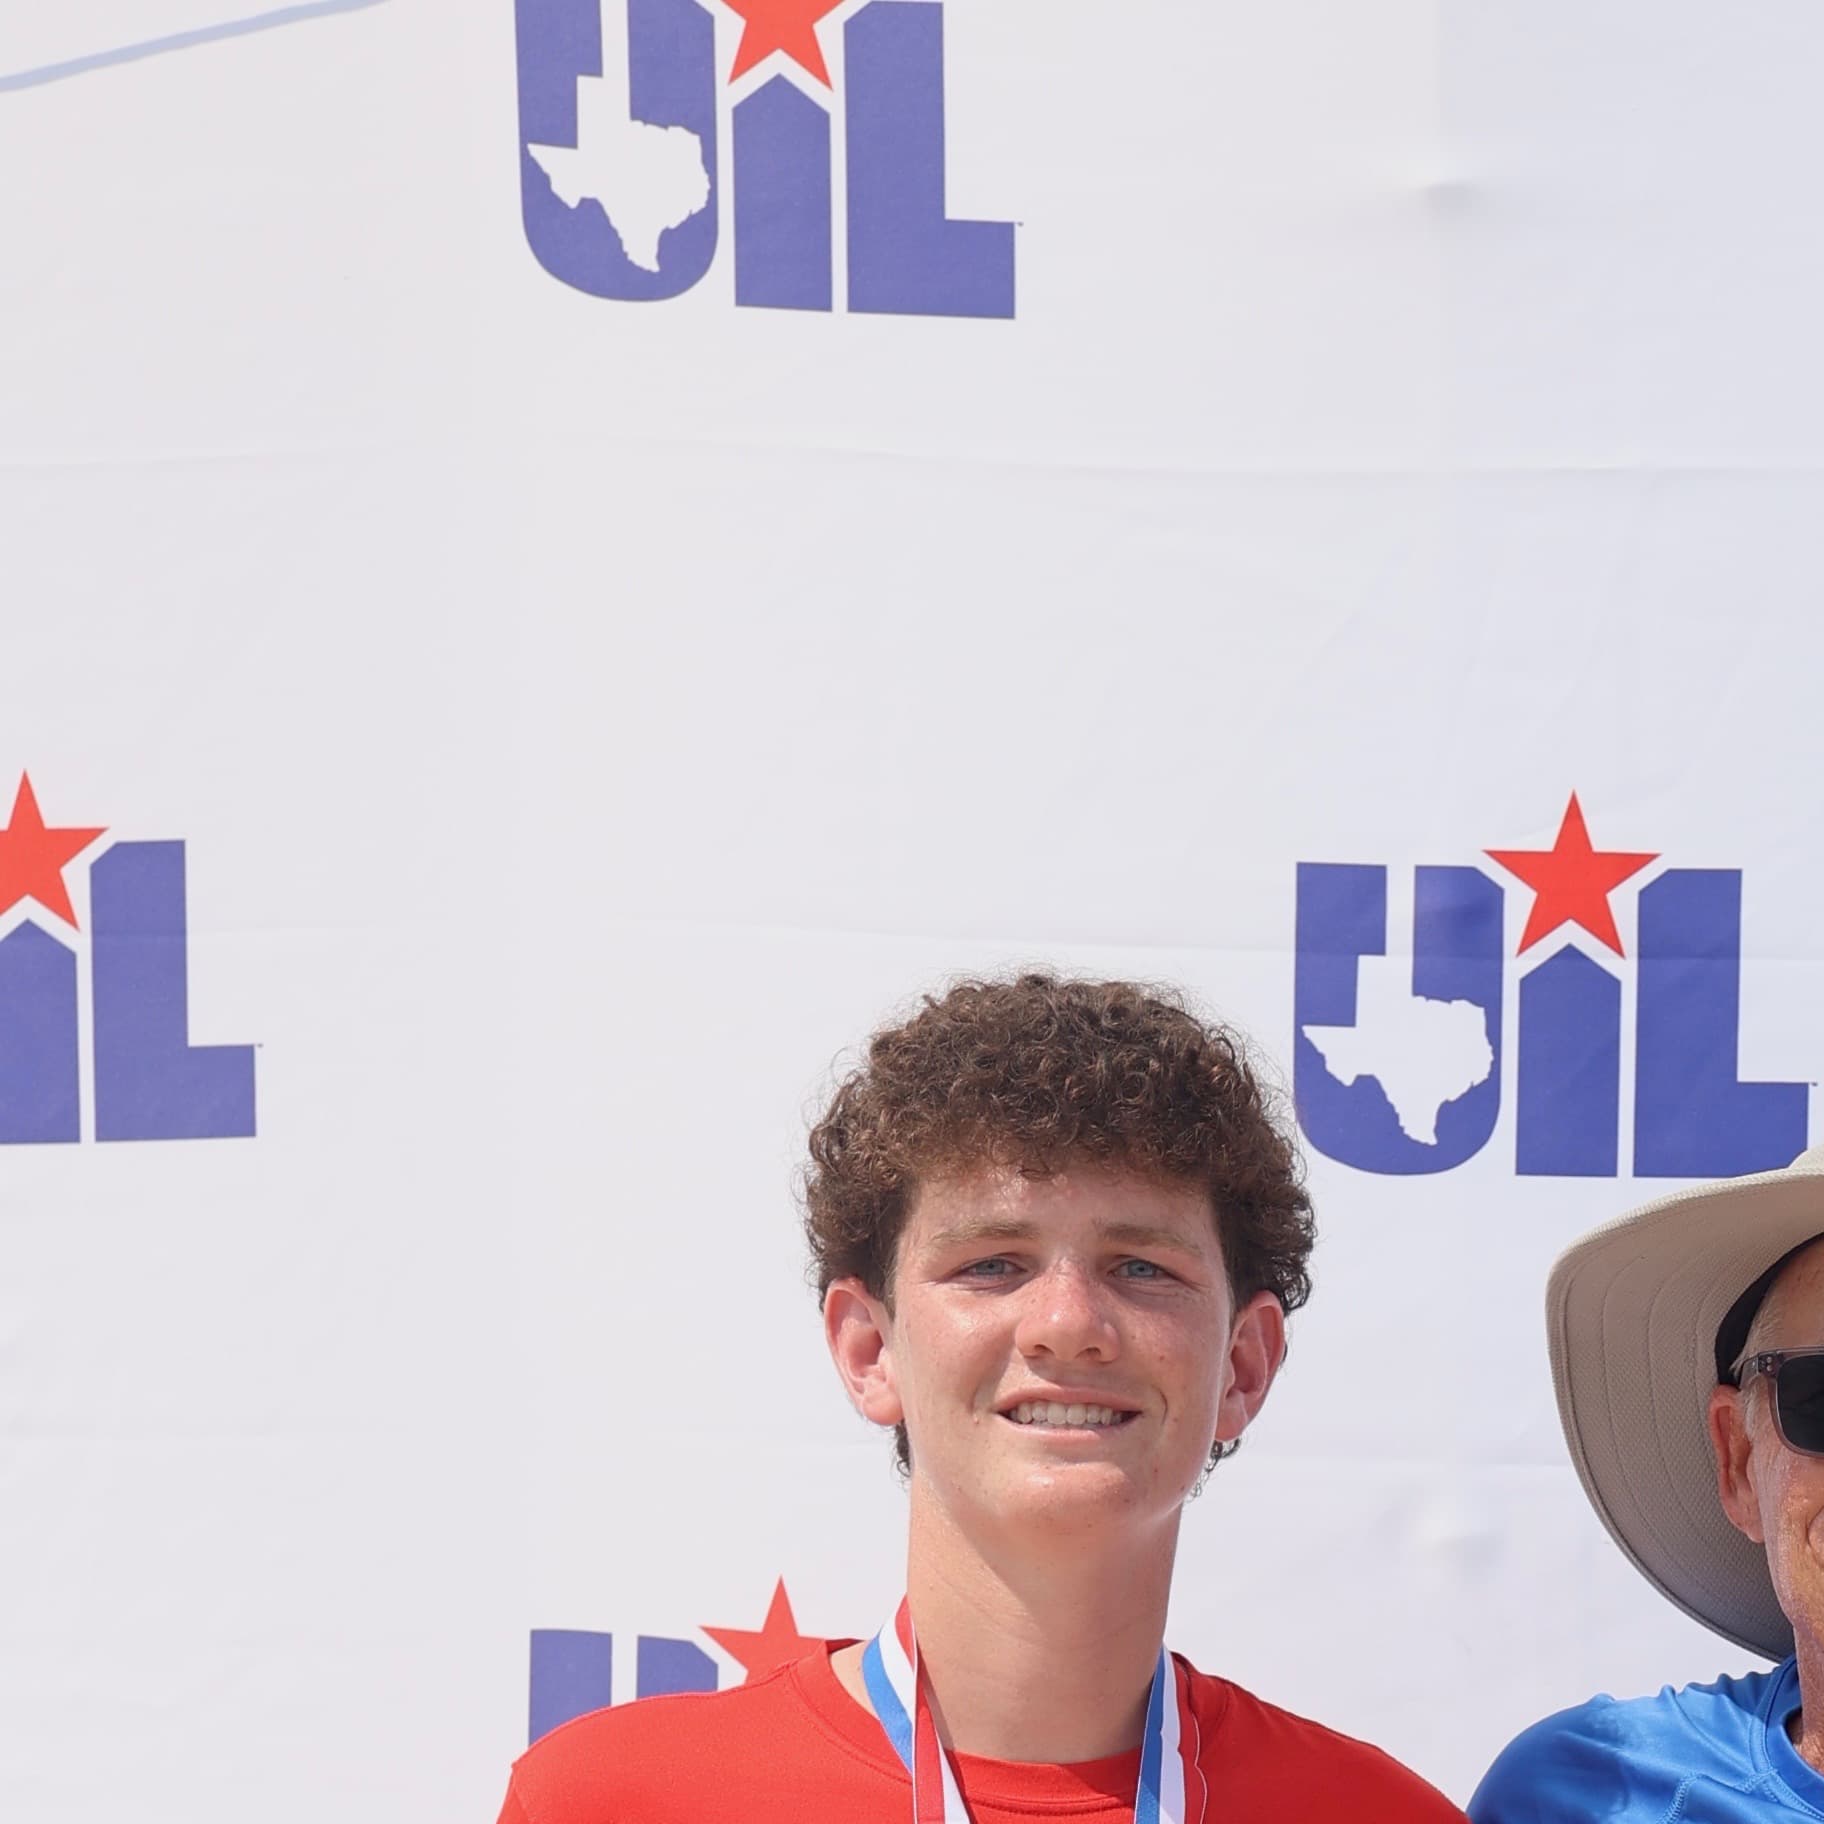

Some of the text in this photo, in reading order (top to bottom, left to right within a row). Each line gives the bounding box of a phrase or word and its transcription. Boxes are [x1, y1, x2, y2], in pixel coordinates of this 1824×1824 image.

[514, 0, 1016, 319] UIL
[0, 839, 256, 1145] IL
[1293, 861, 1810, 1178] UIL
